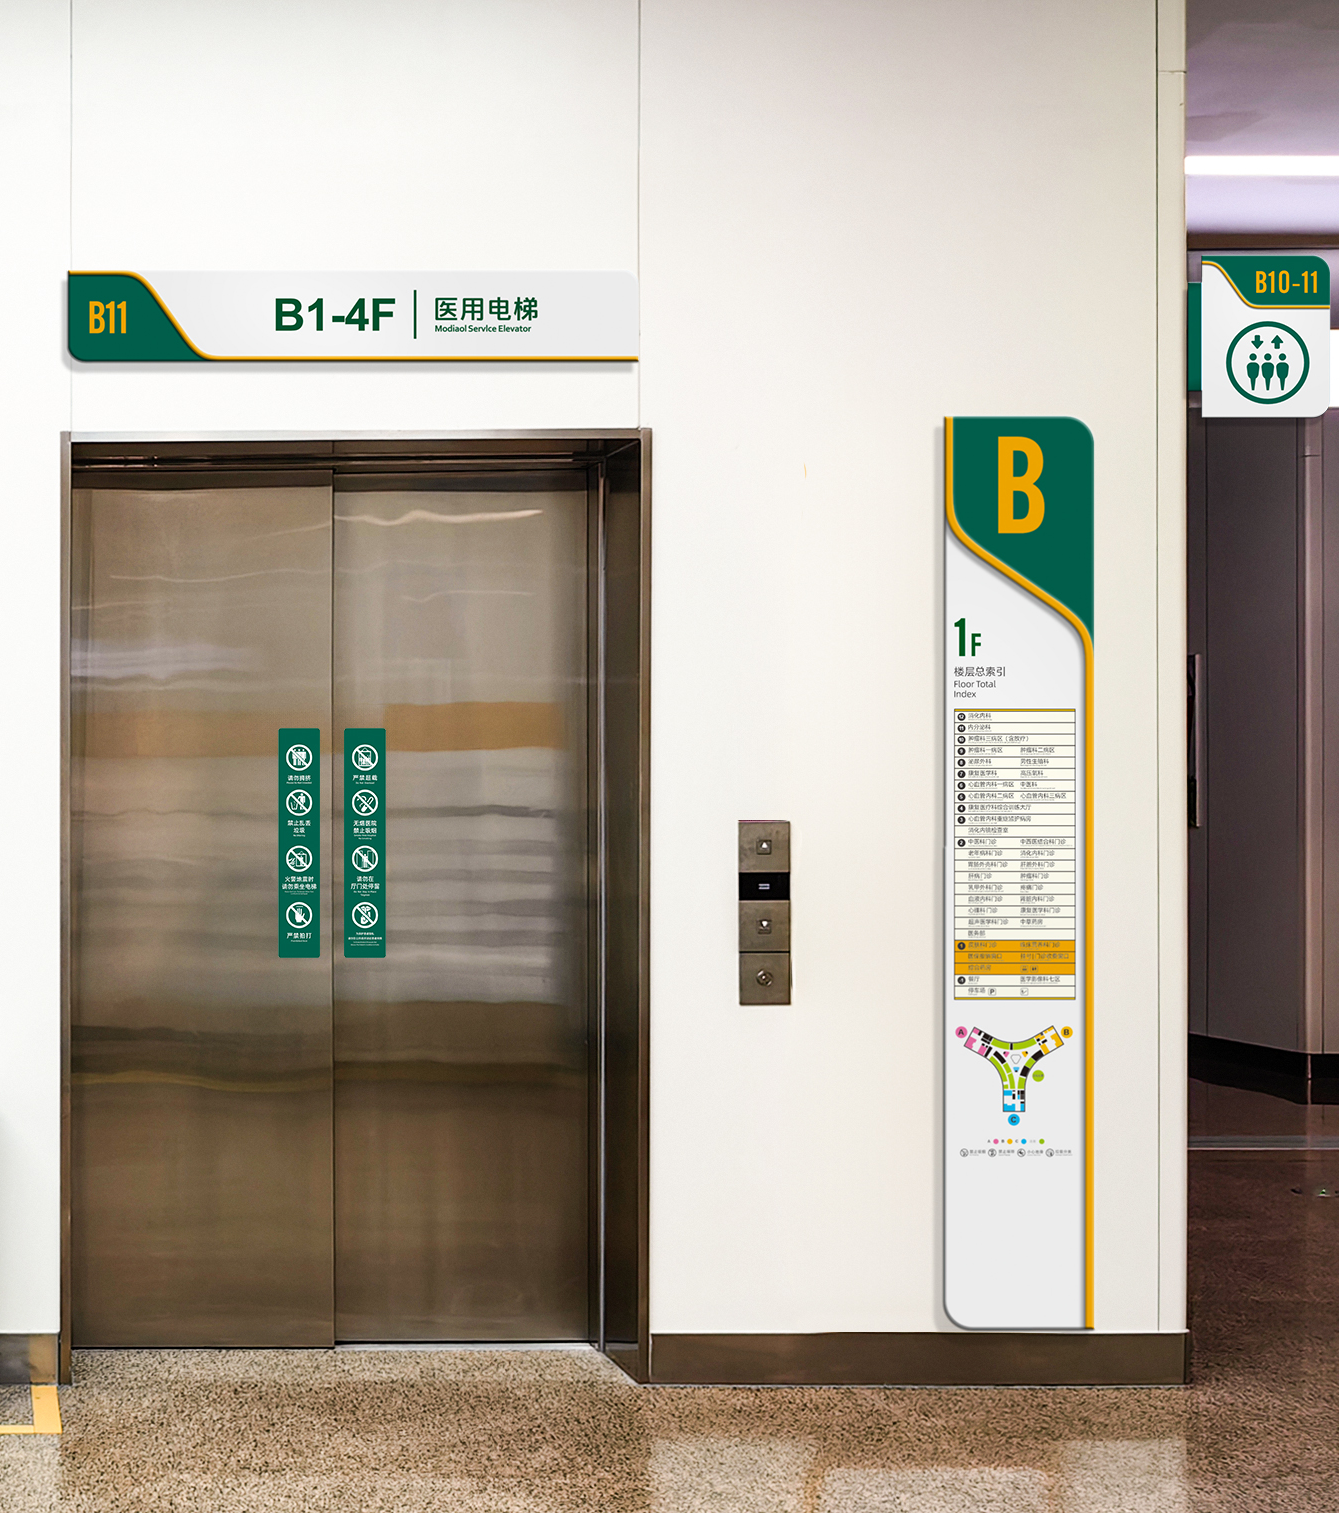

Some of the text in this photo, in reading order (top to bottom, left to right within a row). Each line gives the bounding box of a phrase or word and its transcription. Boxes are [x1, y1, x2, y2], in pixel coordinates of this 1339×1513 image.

[1256, 270, 1317, 293] B10-11
[89, 301, 126, 333] B11
[276, 298, 395, 331] B1-4F
[435, 297, 538, 321] 医用电梯
[998, 436, 1045, 534] B
[954, 618, 981, 656] 1F
[954, 667, 1005, 677] 楼层总索引
[954, 680, 996, 688] Floor Total
[954, 690, 976, 698] Index
